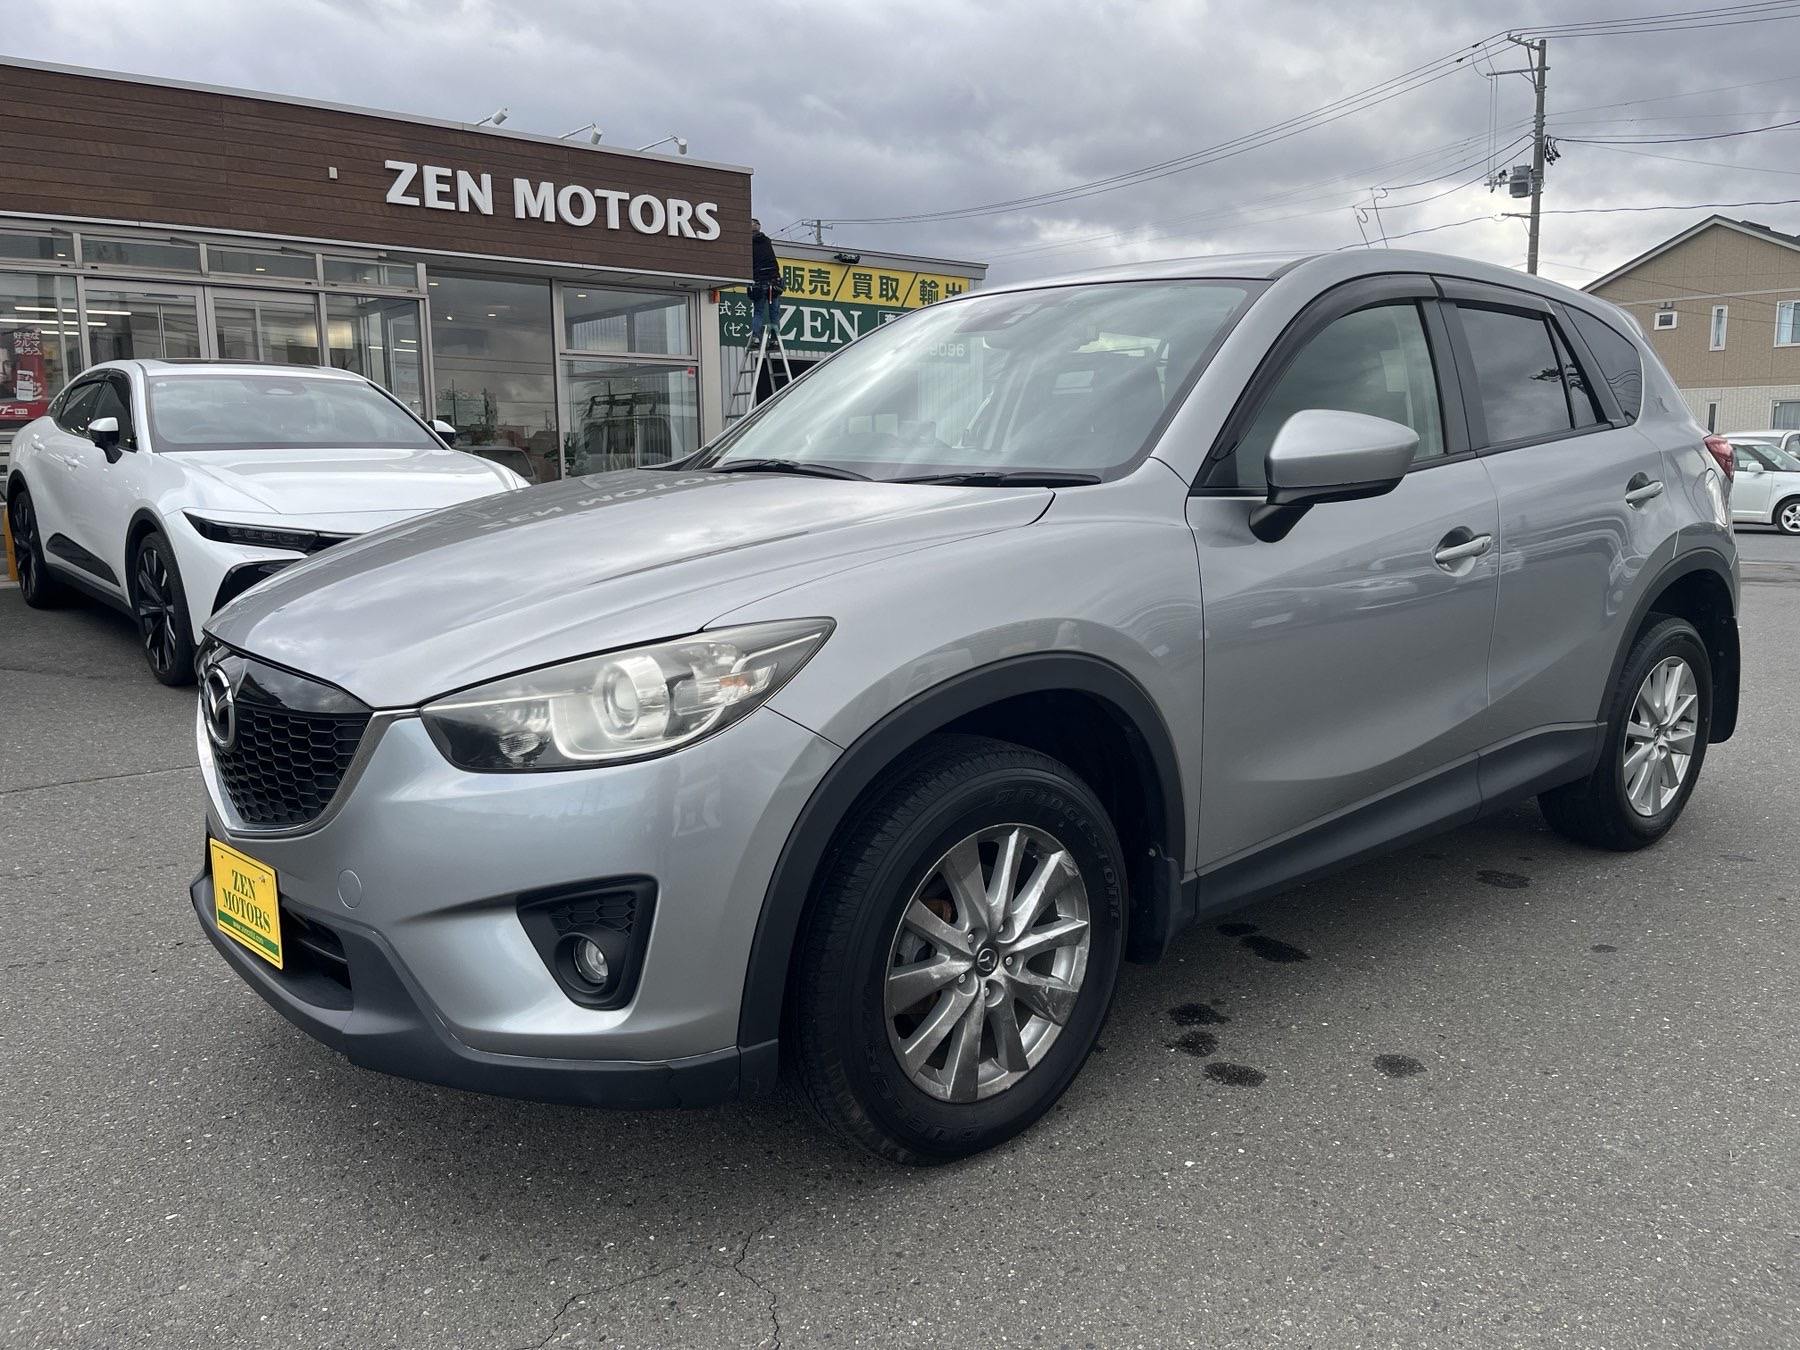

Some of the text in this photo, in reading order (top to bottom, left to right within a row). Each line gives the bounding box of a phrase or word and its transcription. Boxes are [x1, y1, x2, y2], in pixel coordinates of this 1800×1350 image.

[384, 160, 721, 241] ZEN MOTORS
[782, 265, 831, 296] 販売
[852, 272, 900, 302] 買取
[777, 304, 862, 344] ZEN
[232, 869, 256, 901] ZEN
[222, 887, 271, 934] MOTORS
